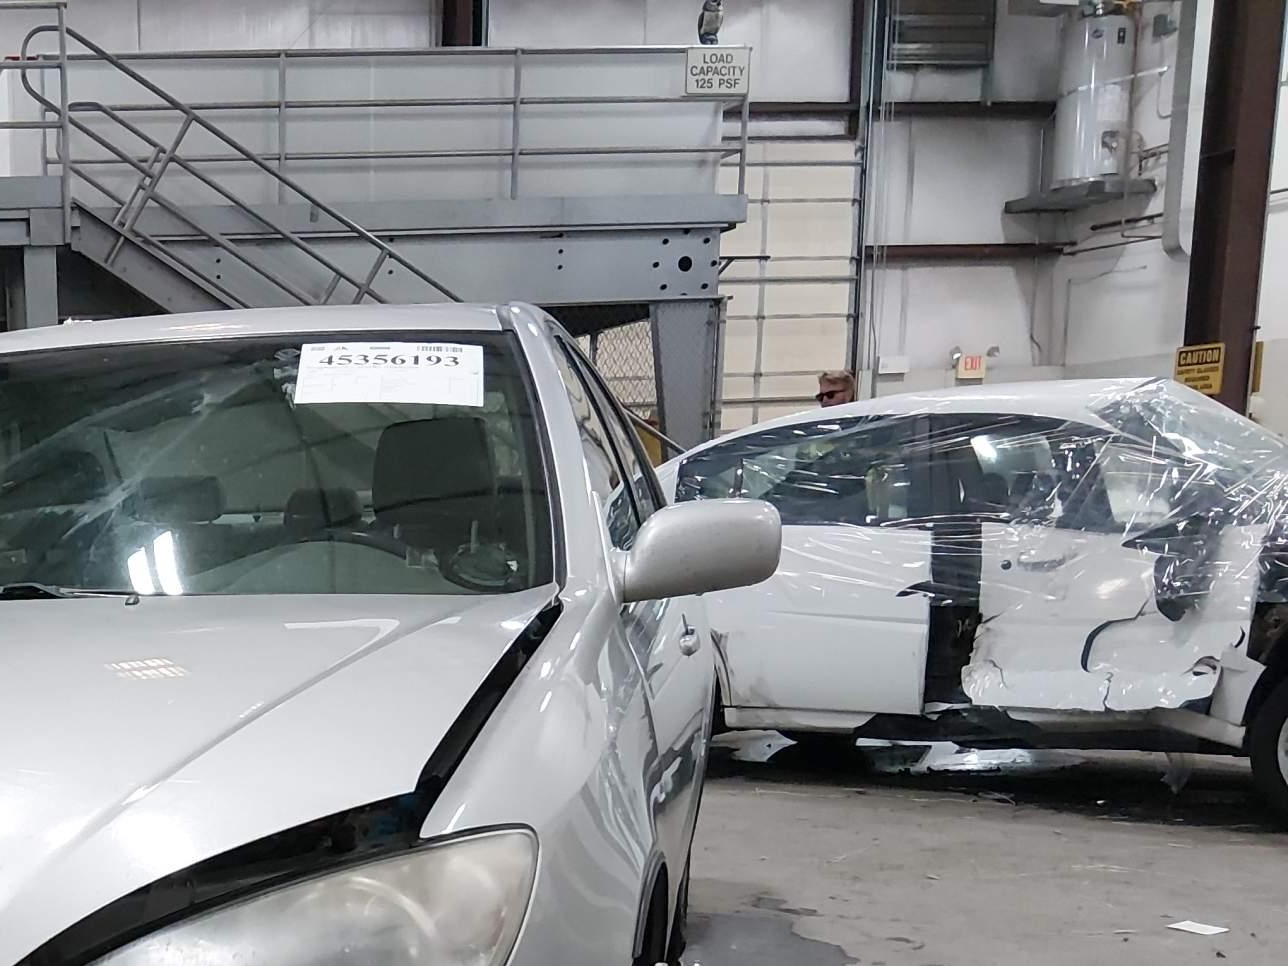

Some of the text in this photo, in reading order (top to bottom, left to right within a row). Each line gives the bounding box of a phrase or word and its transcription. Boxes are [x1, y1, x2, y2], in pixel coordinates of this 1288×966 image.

[702, 53, 734, 64] LOAD
[690, 65, 745, 77] CAPACITY
[695, 78, 740, 89] 125 PSF
[319, 353, 460, 367] 45356193
[1179, 349, 1220, 365] CAUTION
